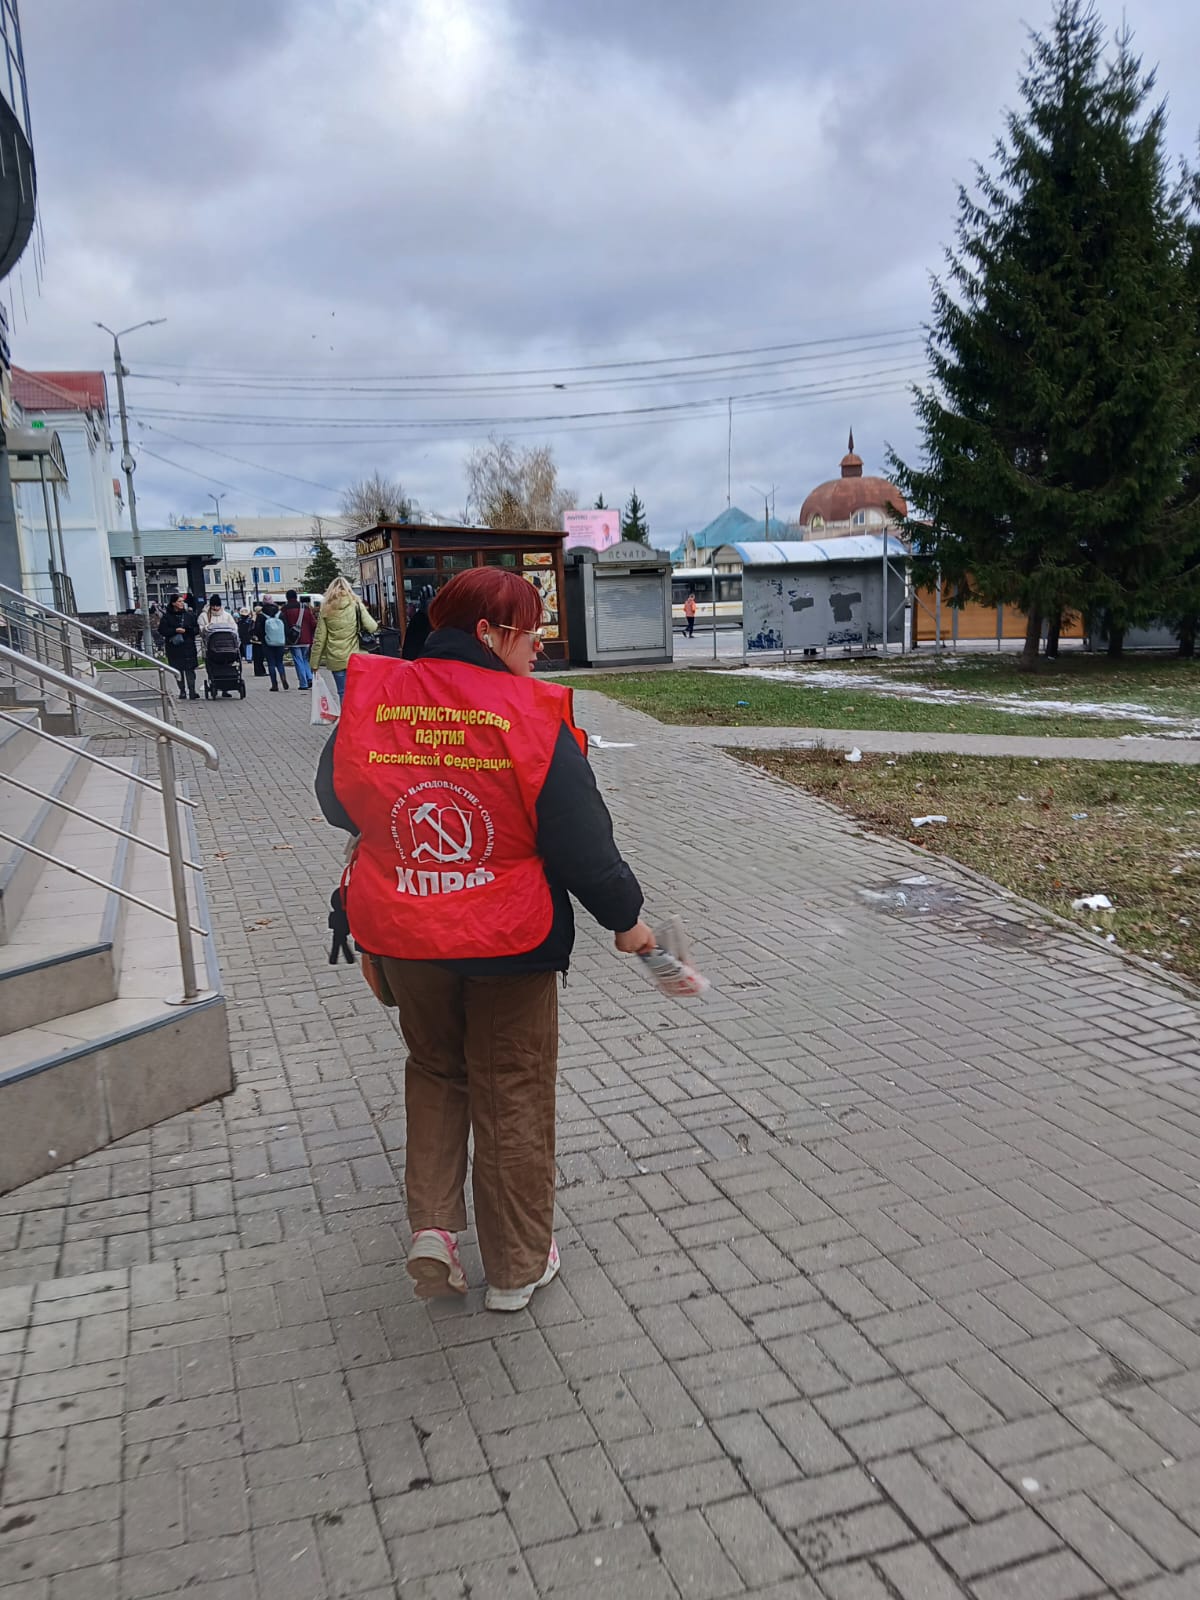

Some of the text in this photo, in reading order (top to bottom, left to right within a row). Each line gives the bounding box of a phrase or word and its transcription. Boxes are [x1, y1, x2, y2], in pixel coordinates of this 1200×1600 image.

[608, 550, 647, 560] ПЕЧАТЬ
[375, 703, 511, 733] Коммунистическая
[415, 728, 465, 749] партия
[368, 750, 514, 771] Российской Федерации
[390, 797, 406, 818] ТРУД
[407, 780, 480, 806] НАРОДОВЛАСТИЕ
[395, 866, 496, 897] КПРФ
